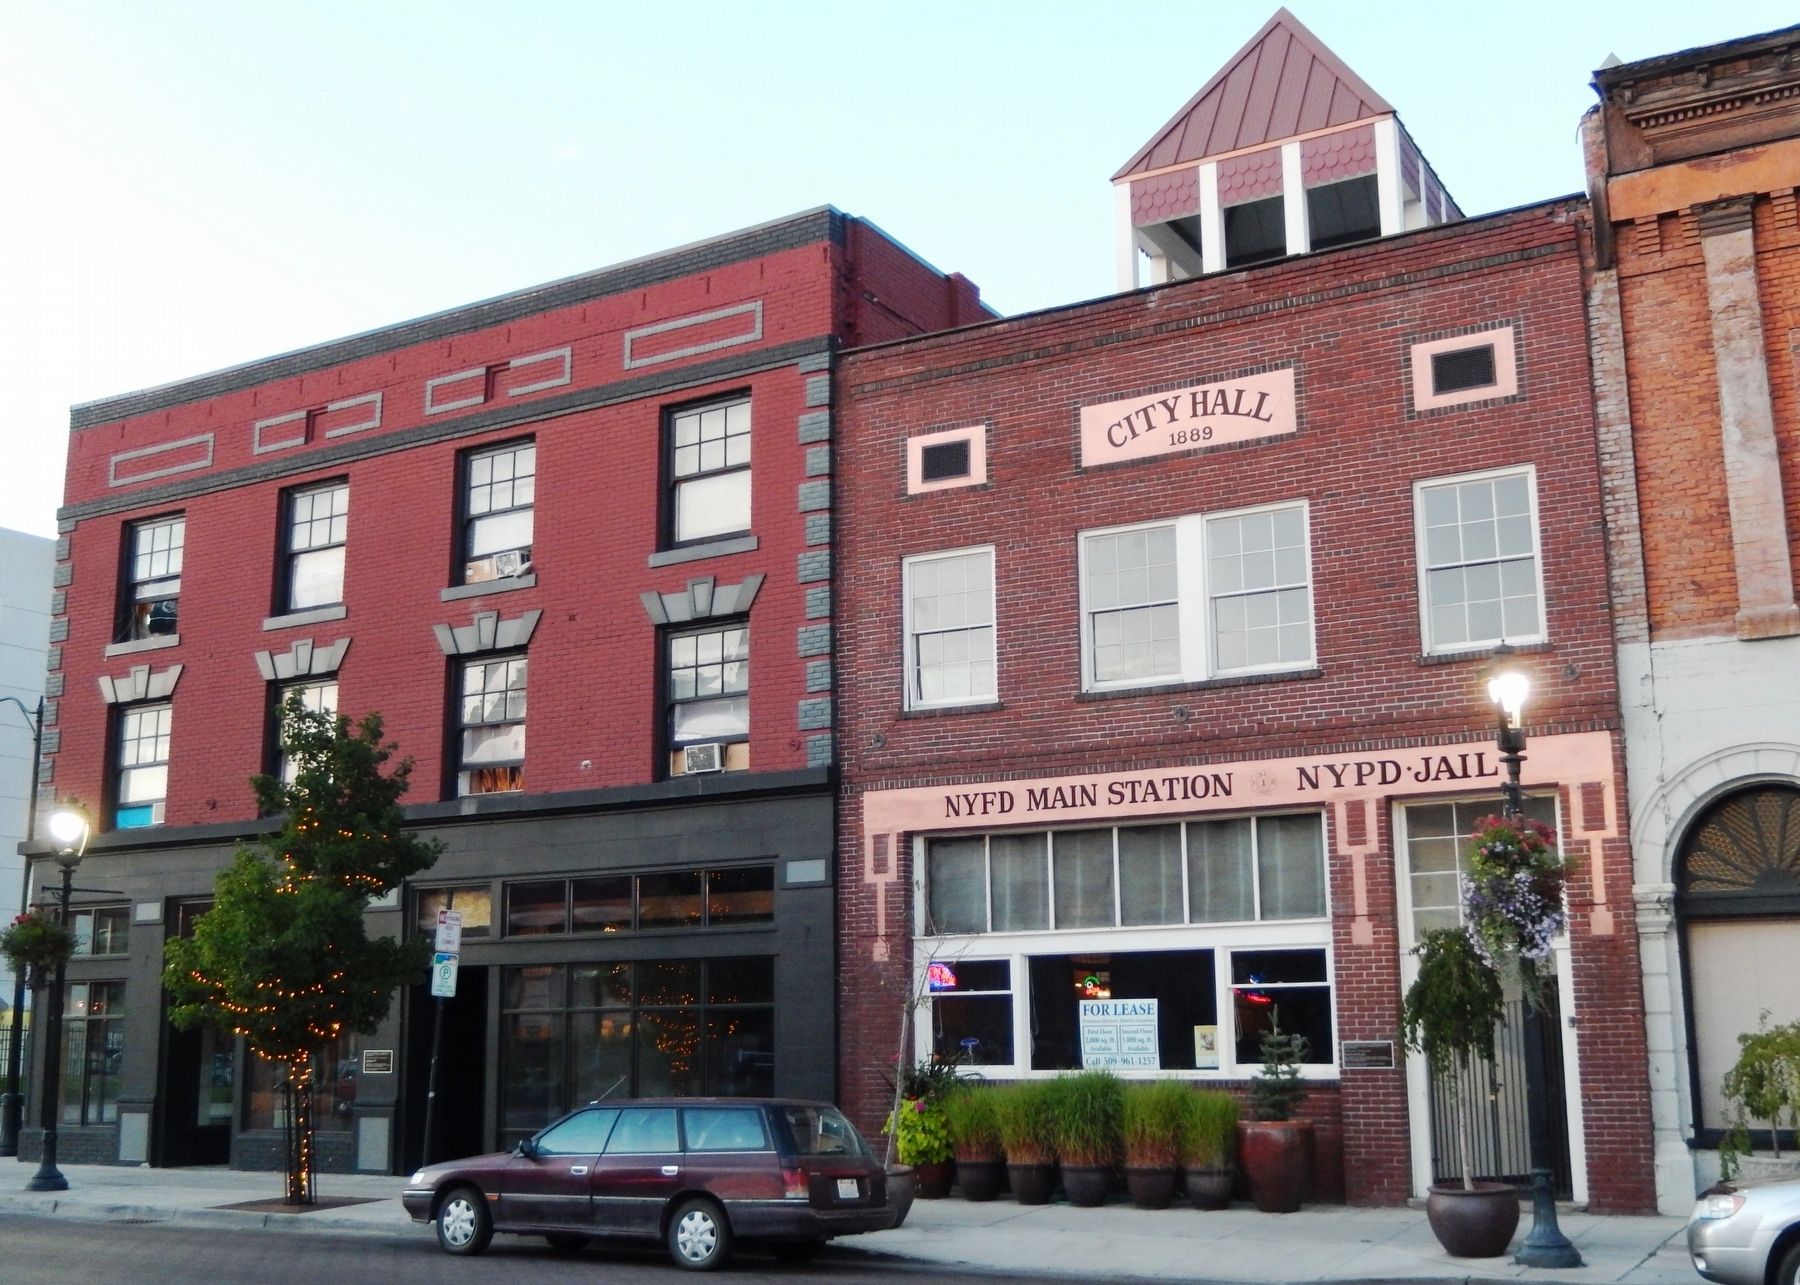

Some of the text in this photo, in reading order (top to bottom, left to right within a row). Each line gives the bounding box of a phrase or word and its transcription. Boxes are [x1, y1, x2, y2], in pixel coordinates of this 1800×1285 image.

[1107, 388, 1273, 448] CITY HALL
[1169, 426, 1213, 446] 1889
[945, 791, 1015, 818] NYFD
[1026, 783, 1098, 812] MAIN
[1107, 773, 1234, 805] STATION
[1083, 1002, 1155, 1016] FOR LEASE
[1086, 1057, 1101, 1065] Call
